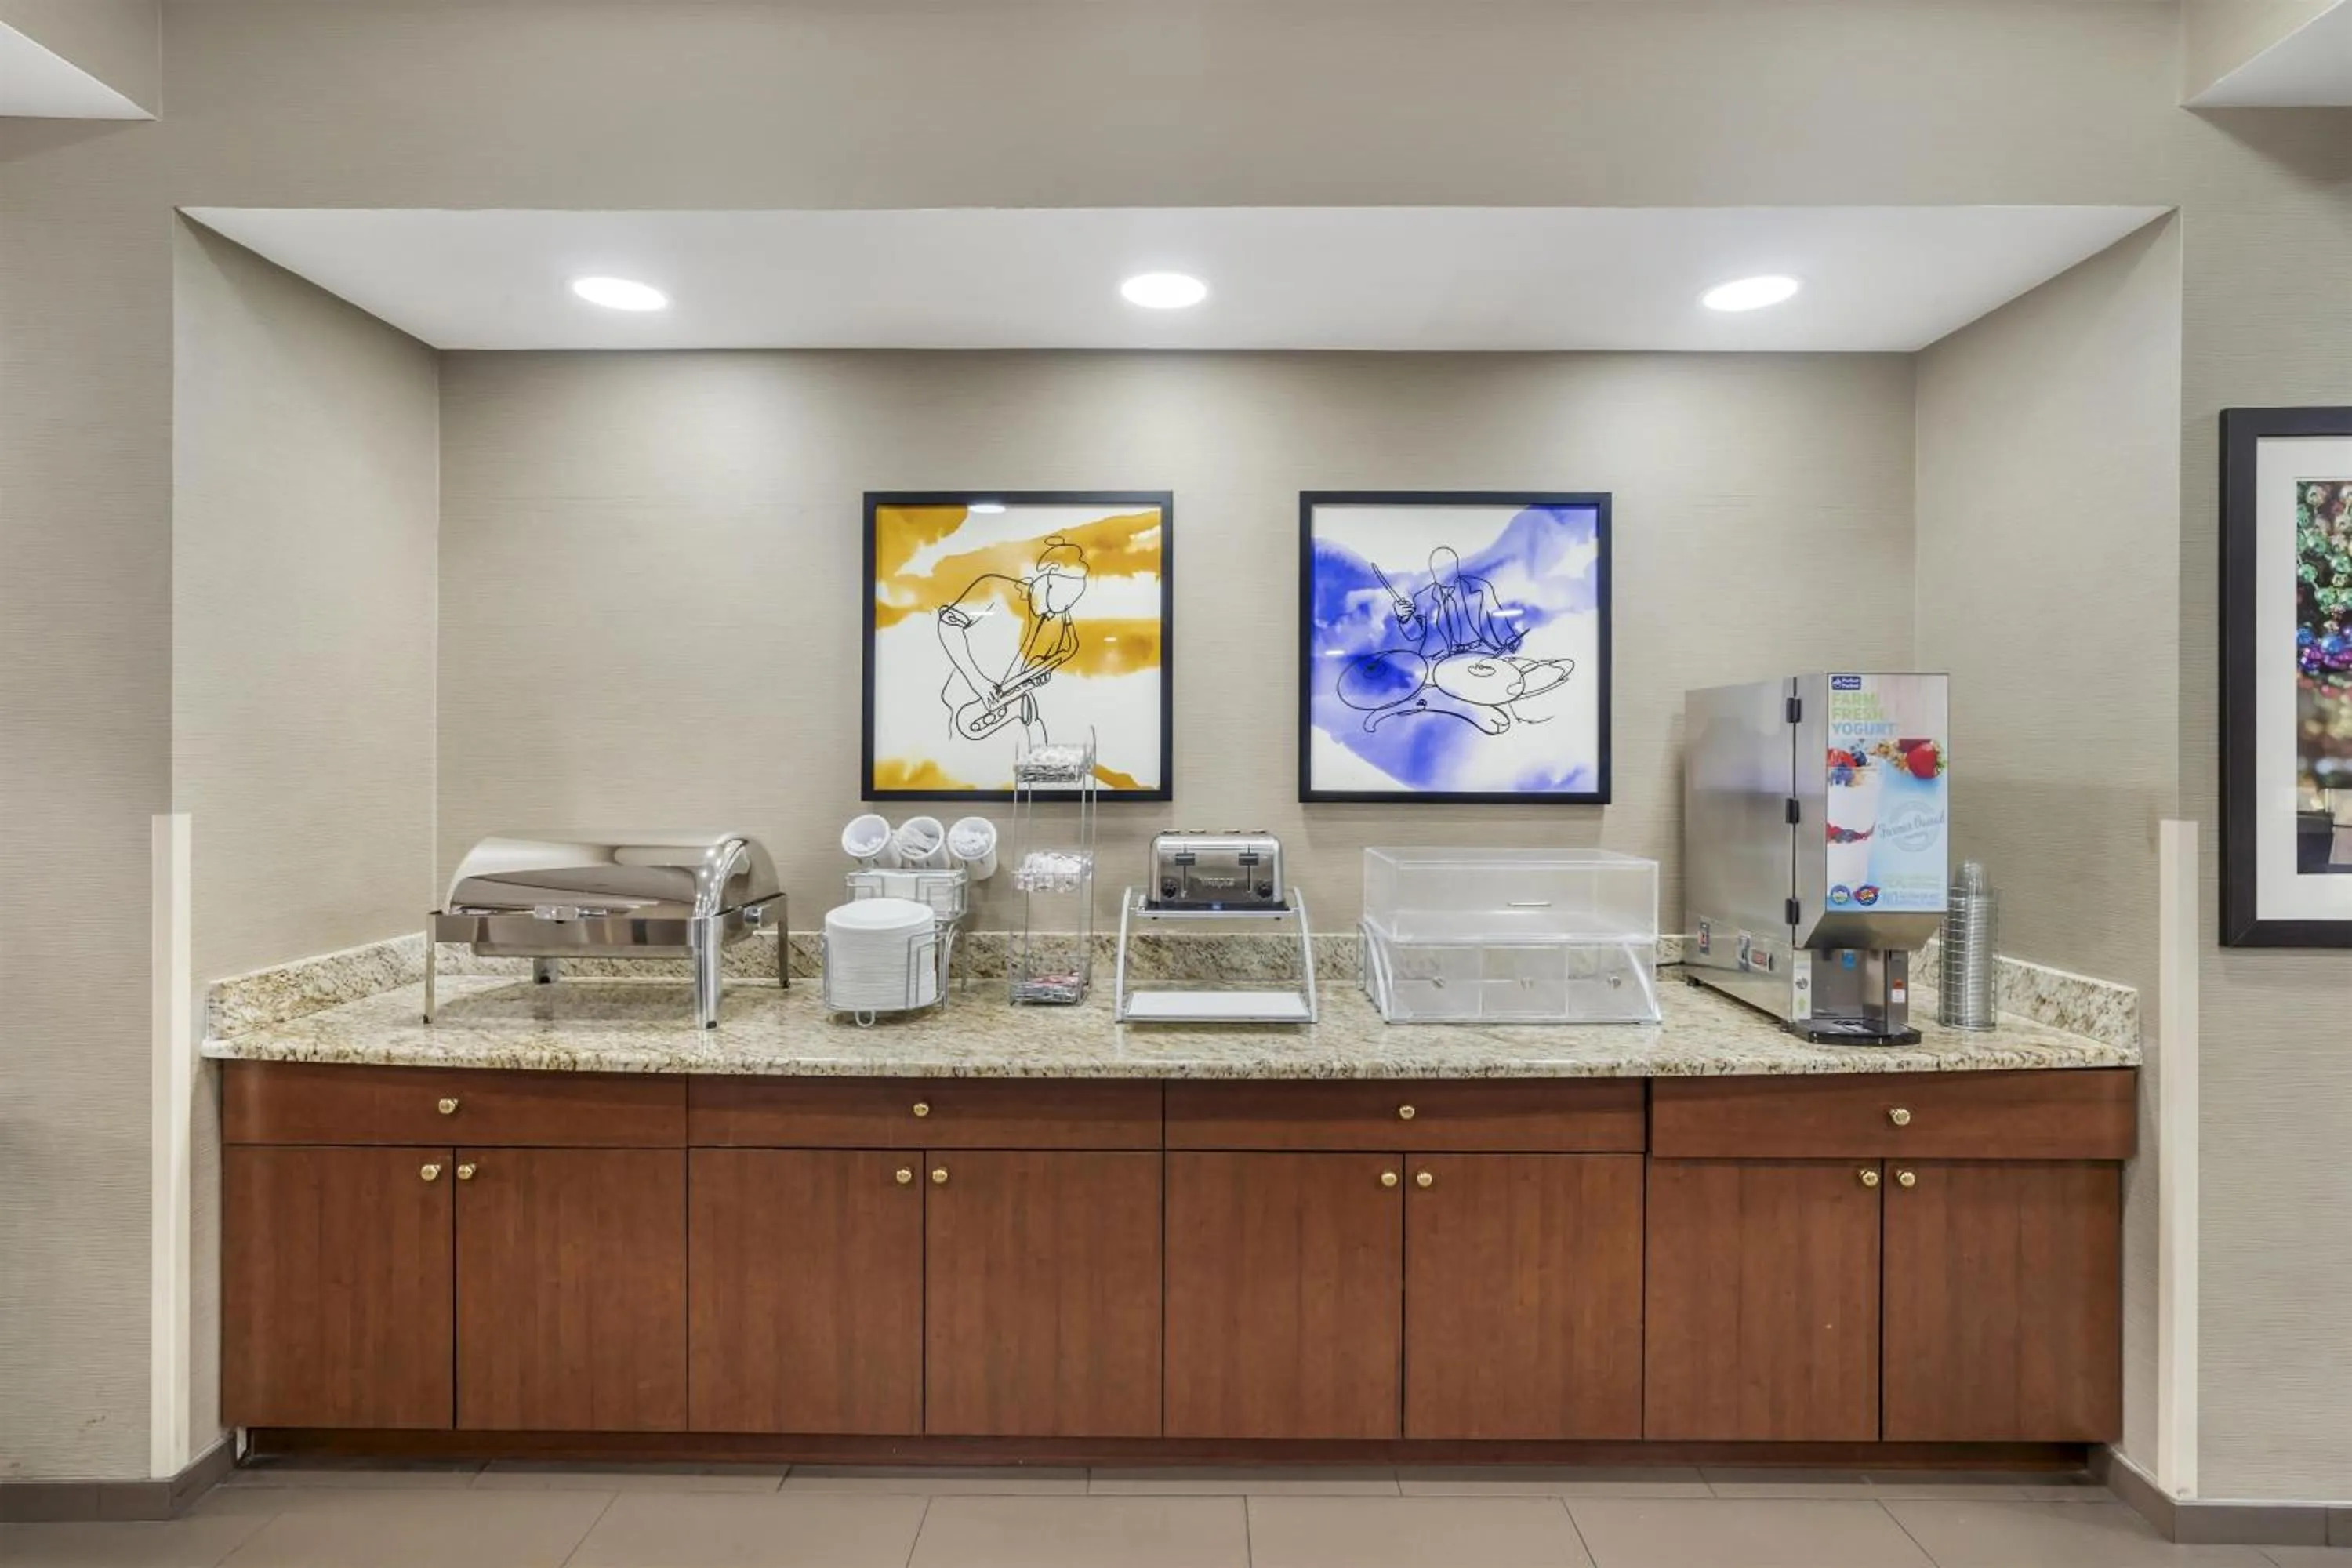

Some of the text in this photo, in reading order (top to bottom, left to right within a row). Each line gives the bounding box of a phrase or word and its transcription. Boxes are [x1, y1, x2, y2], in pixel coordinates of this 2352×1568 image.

[1832, 692, 1878, 705] FARM
[1832, 707, 1883, 720] FRESH
[1831, 722, 1896, 735] YOGURT
